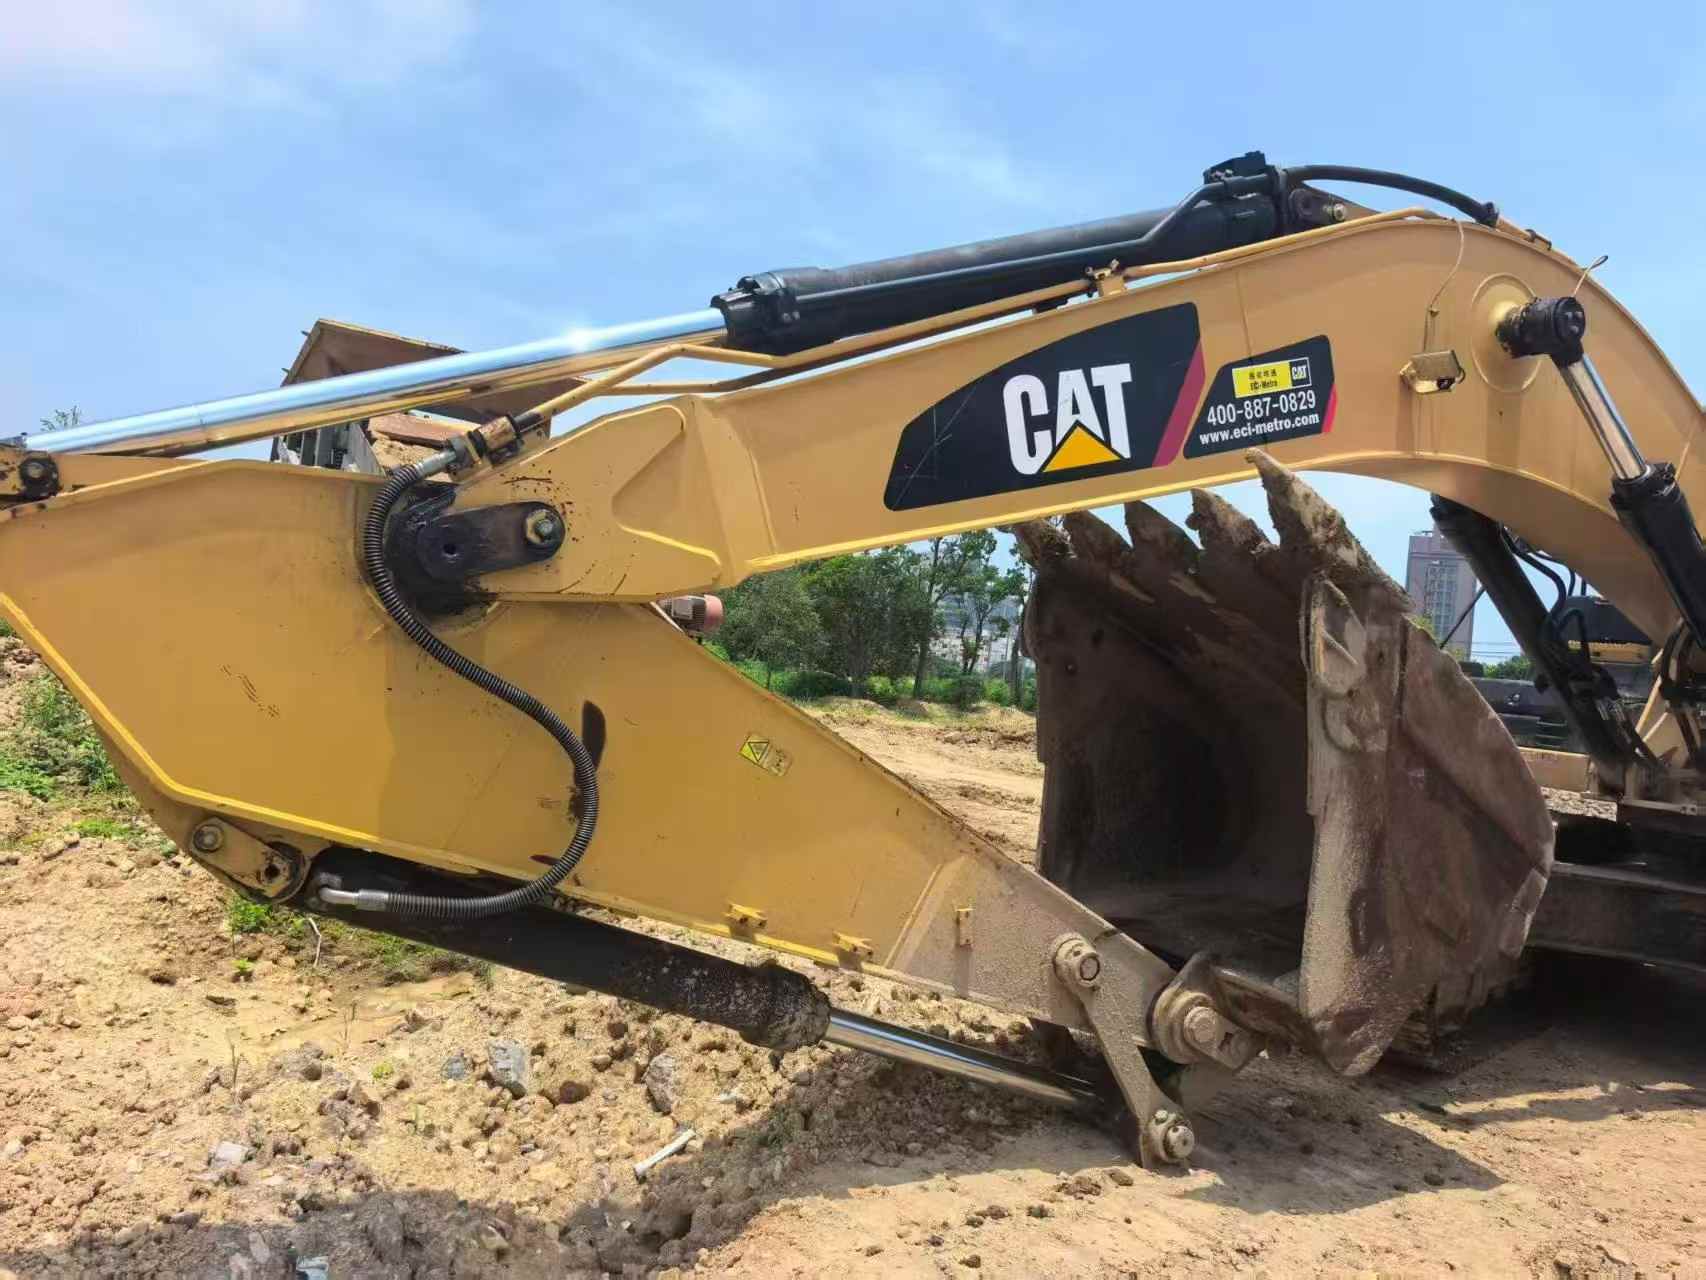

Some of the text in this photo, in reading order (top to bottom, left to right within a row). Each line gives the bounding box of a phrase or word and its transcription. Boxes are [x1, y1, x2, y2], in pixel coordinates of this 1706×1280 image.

[1292, 365, 1307, 380] CAT
[1003, 363, 1132, 475] CAT
[1207, 389, 1316, 426] 400-887-0829
[1199, 413, 1320, 445] www.eci-metro.com
